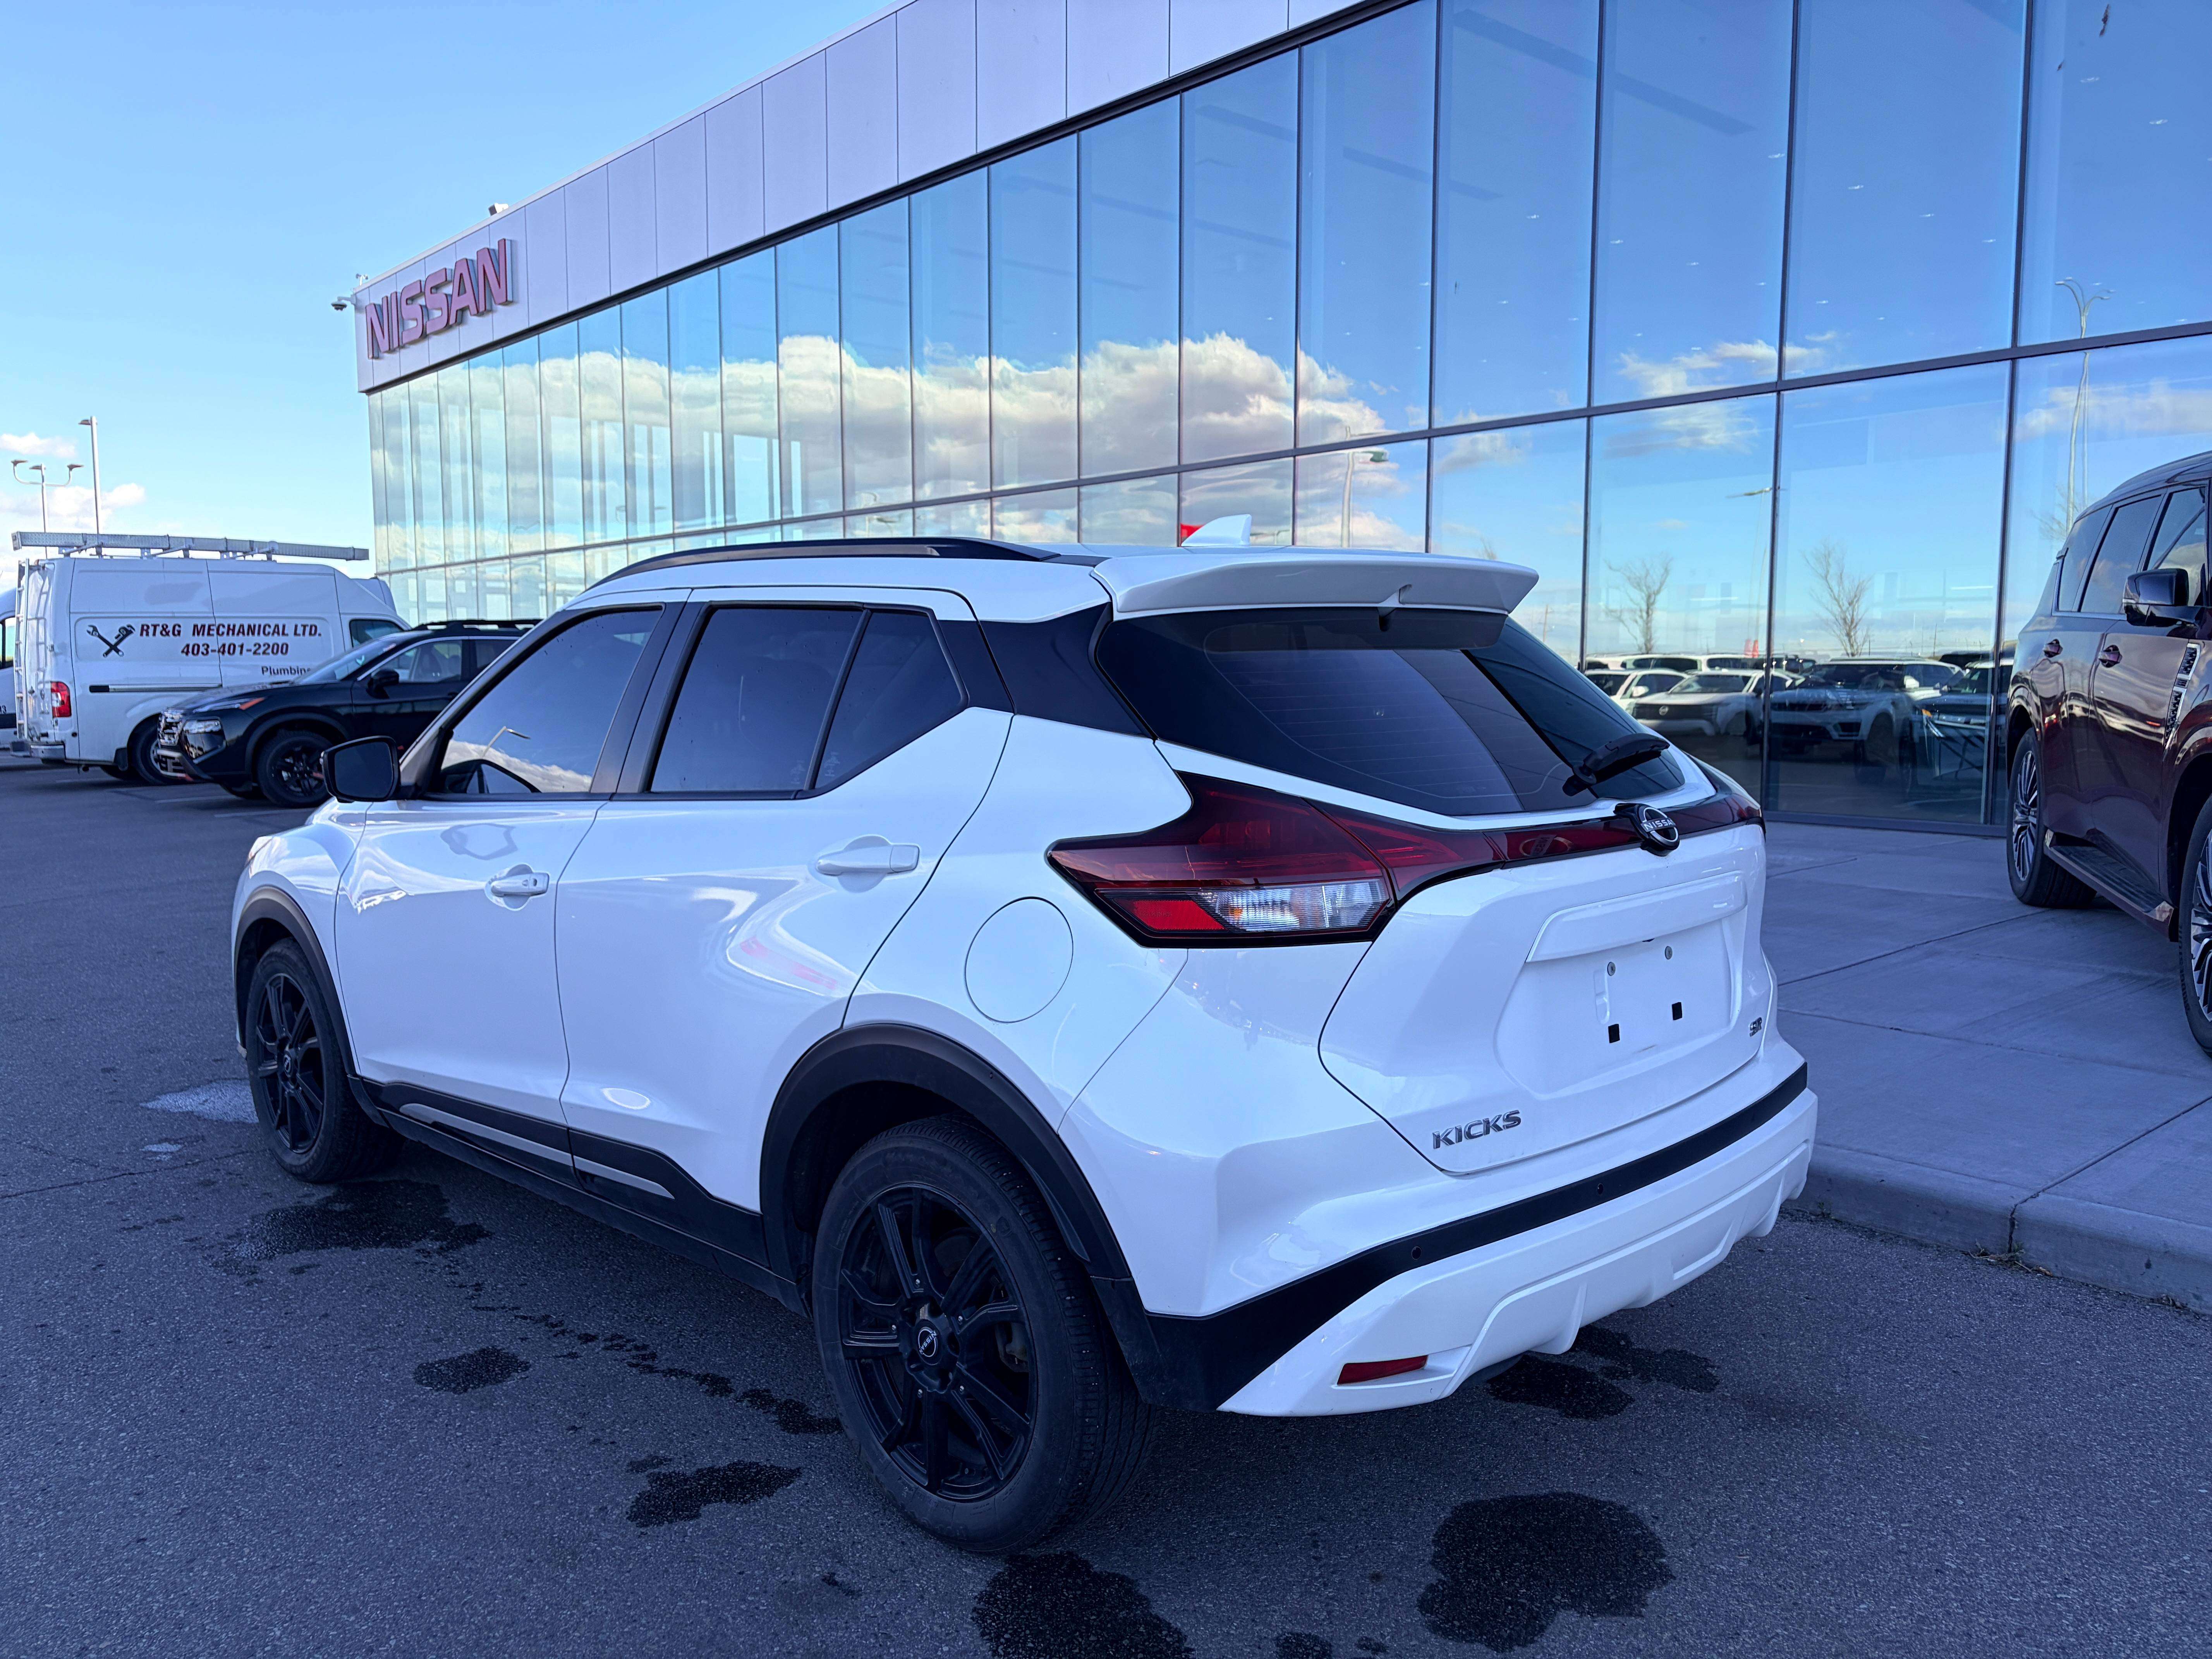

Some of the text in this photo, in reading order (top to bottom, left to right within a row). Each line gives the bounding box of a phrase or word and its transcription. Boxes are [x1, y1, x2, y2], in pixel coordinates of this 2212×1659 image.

[365, 238, 513, 359] NISSAN
[140, 623, 322, 637] RT&G MECHANICAL LTD.
[181, 642, 289, 657] 403-401-2200
[1432, 1109, 1522, 1149] KICKS
[919, 1331, 937, 1355] NISSAN
